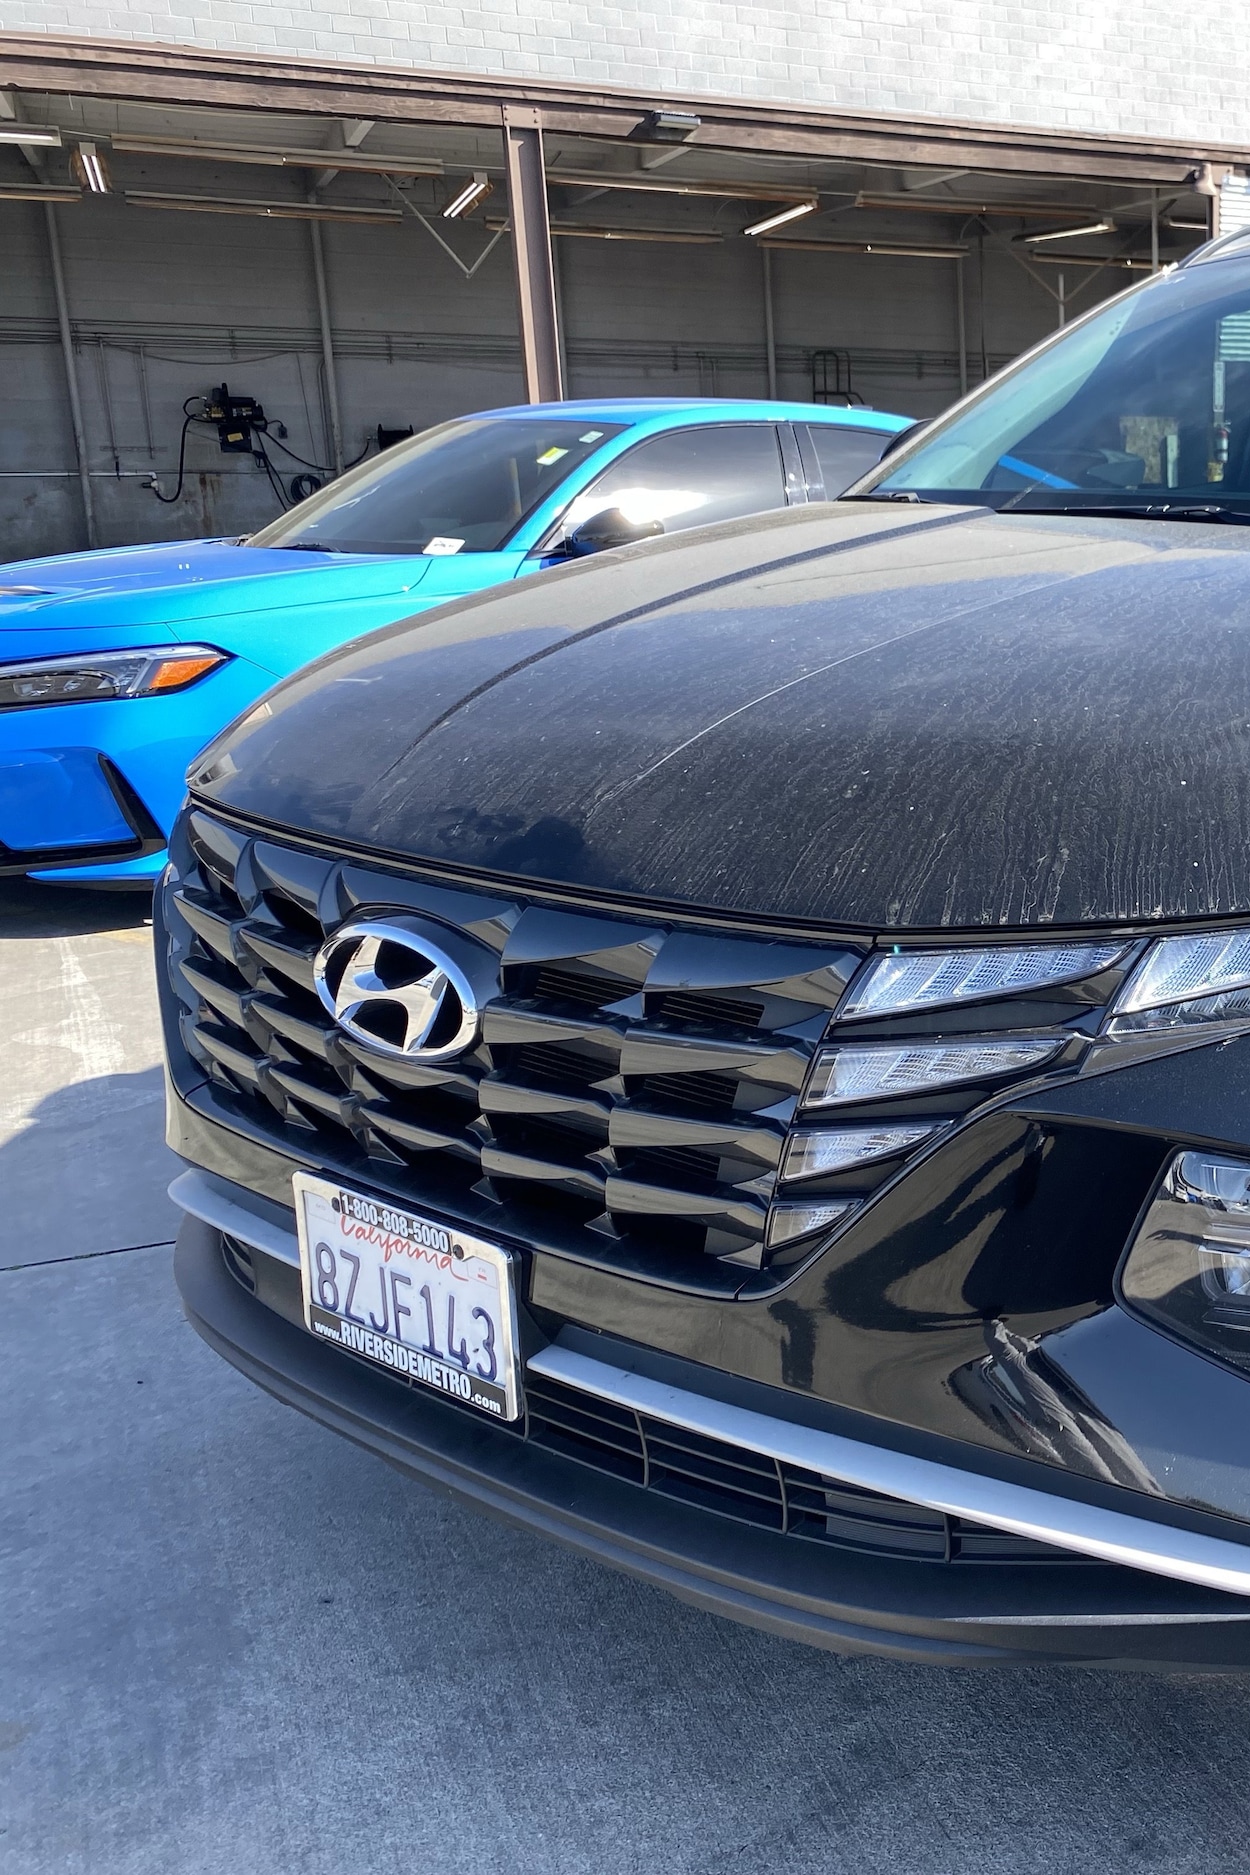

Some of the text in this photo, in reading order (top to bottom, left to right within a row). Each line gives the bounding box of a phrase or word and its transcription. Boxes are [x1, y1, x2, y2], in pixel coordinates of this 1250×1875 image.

[340, 1215, 469, 1281] California
[342, 1194, 449, 1253] 1-800-808-5000
[316, 1242, 497, 1381] 8ZJF143
[314, 1321, 501, 1413] www.RIVERSIDEMETRO.com
